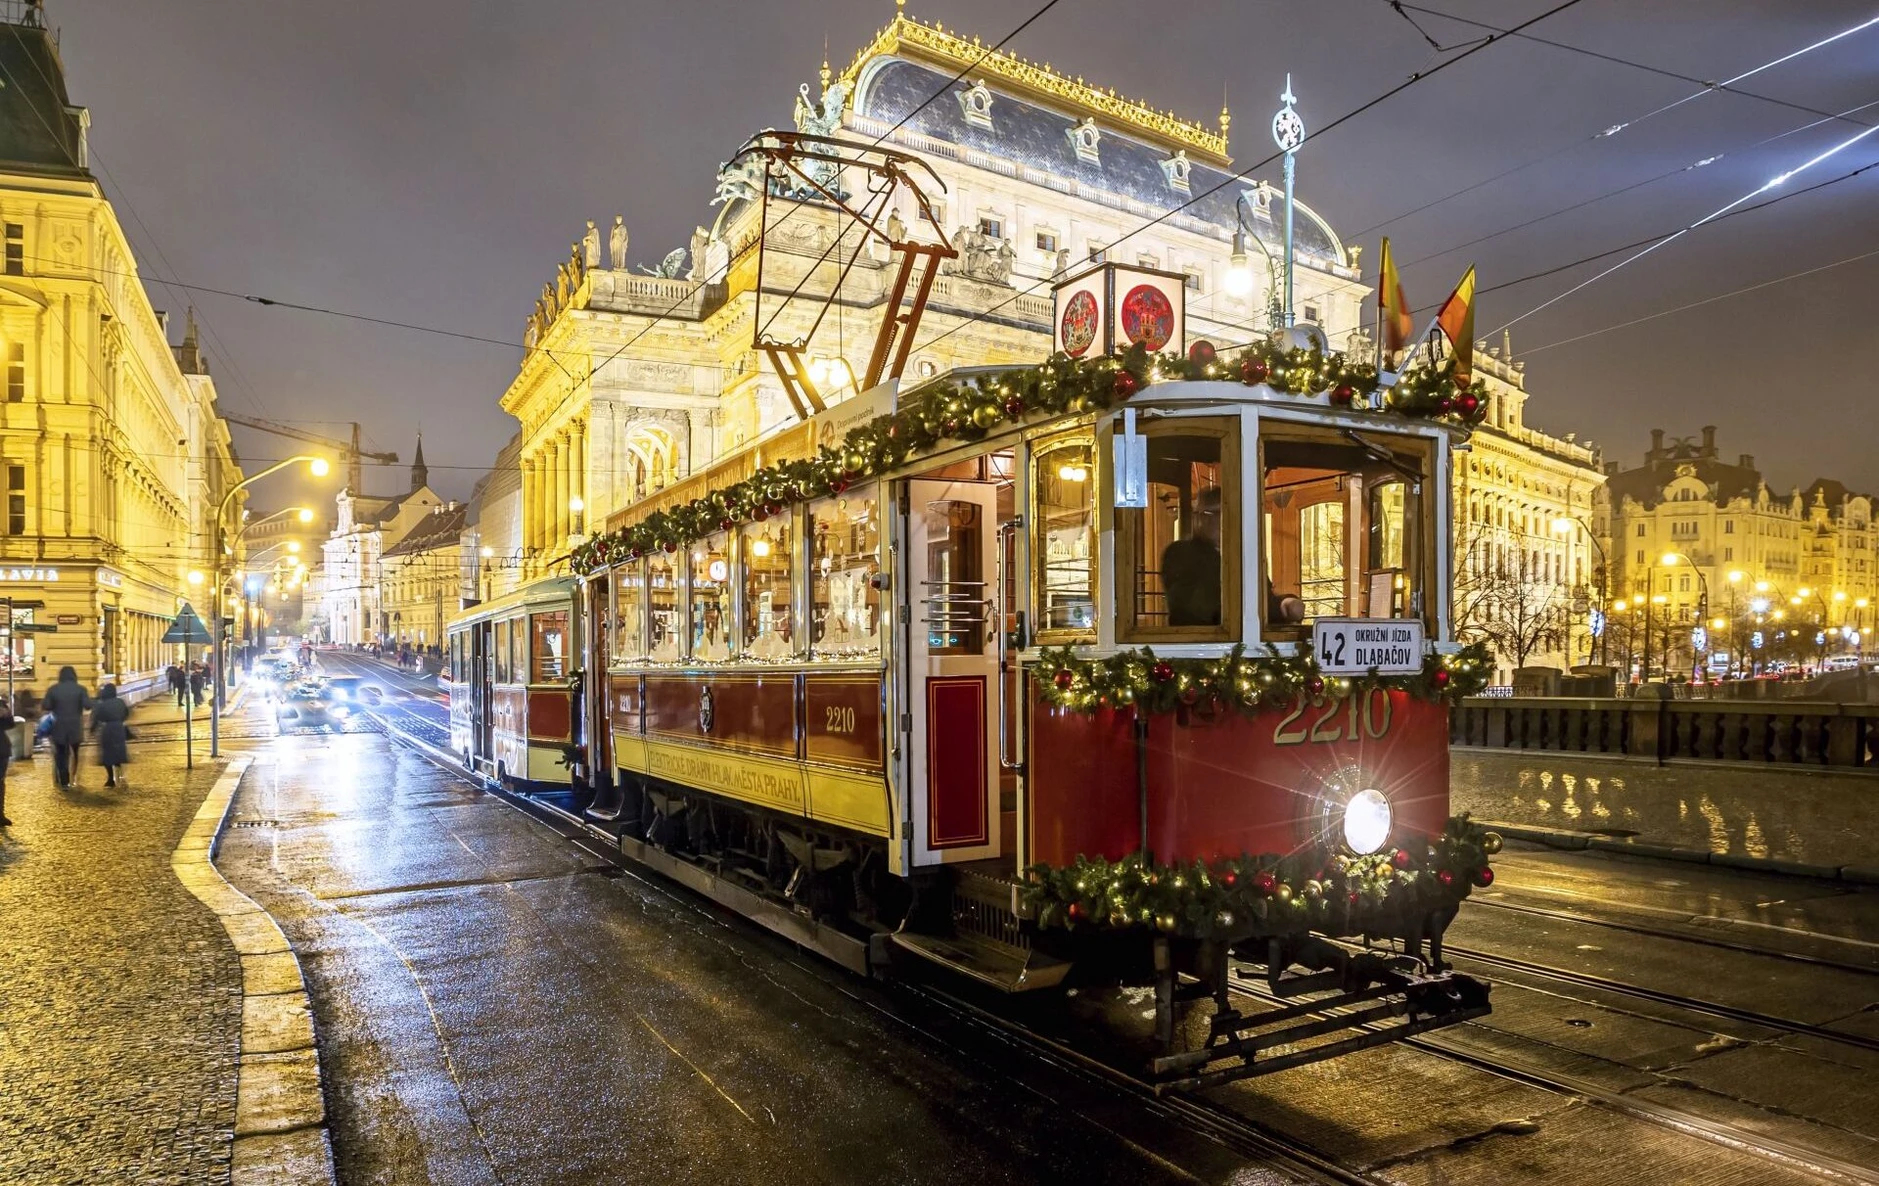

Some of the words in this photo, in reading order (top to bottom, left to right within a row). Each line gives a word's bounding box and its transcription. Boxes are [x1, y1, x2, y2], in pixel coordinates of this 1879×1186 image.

[1321, 631, 1346, 666] 42
[1355, 627, 1389, 643] OKRUŽNÍ
[1392, 627, 1412, 643] JÍZDA
[1356, 645, 1411, 666] DLABAČOV
[826, 705, 855, 733] 2210
[1273, 687, 1392, 744] 2210
